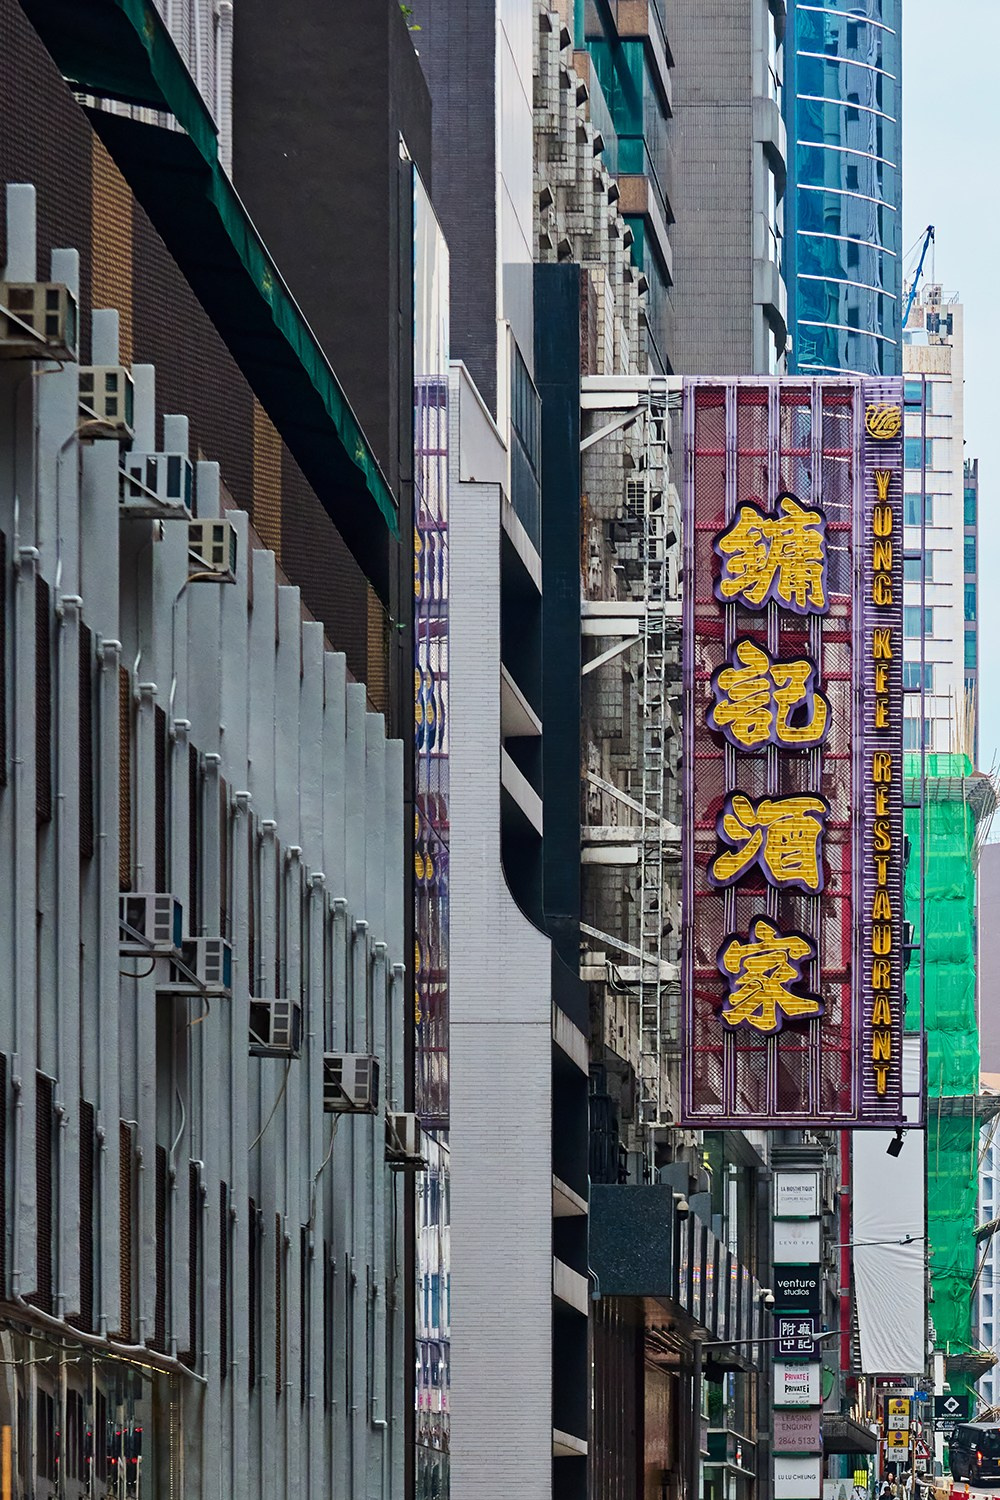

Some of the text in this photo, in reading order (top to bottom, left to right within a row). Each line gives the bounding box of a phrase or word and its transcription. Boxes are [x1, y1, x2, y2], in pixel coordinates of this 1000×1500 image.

[713, 496, 830, 1033] 鏞記酒家
[872, 469, 894, 1099] YUNG KEE RESTAURANT
[777, 1279, 816, 1289] venture
[784, 1373, 806, 1382] PRIVATE
[784, 1385, 806, 1394] PRIVATE
[778, 1437, 816, 1445] 2846 5133
